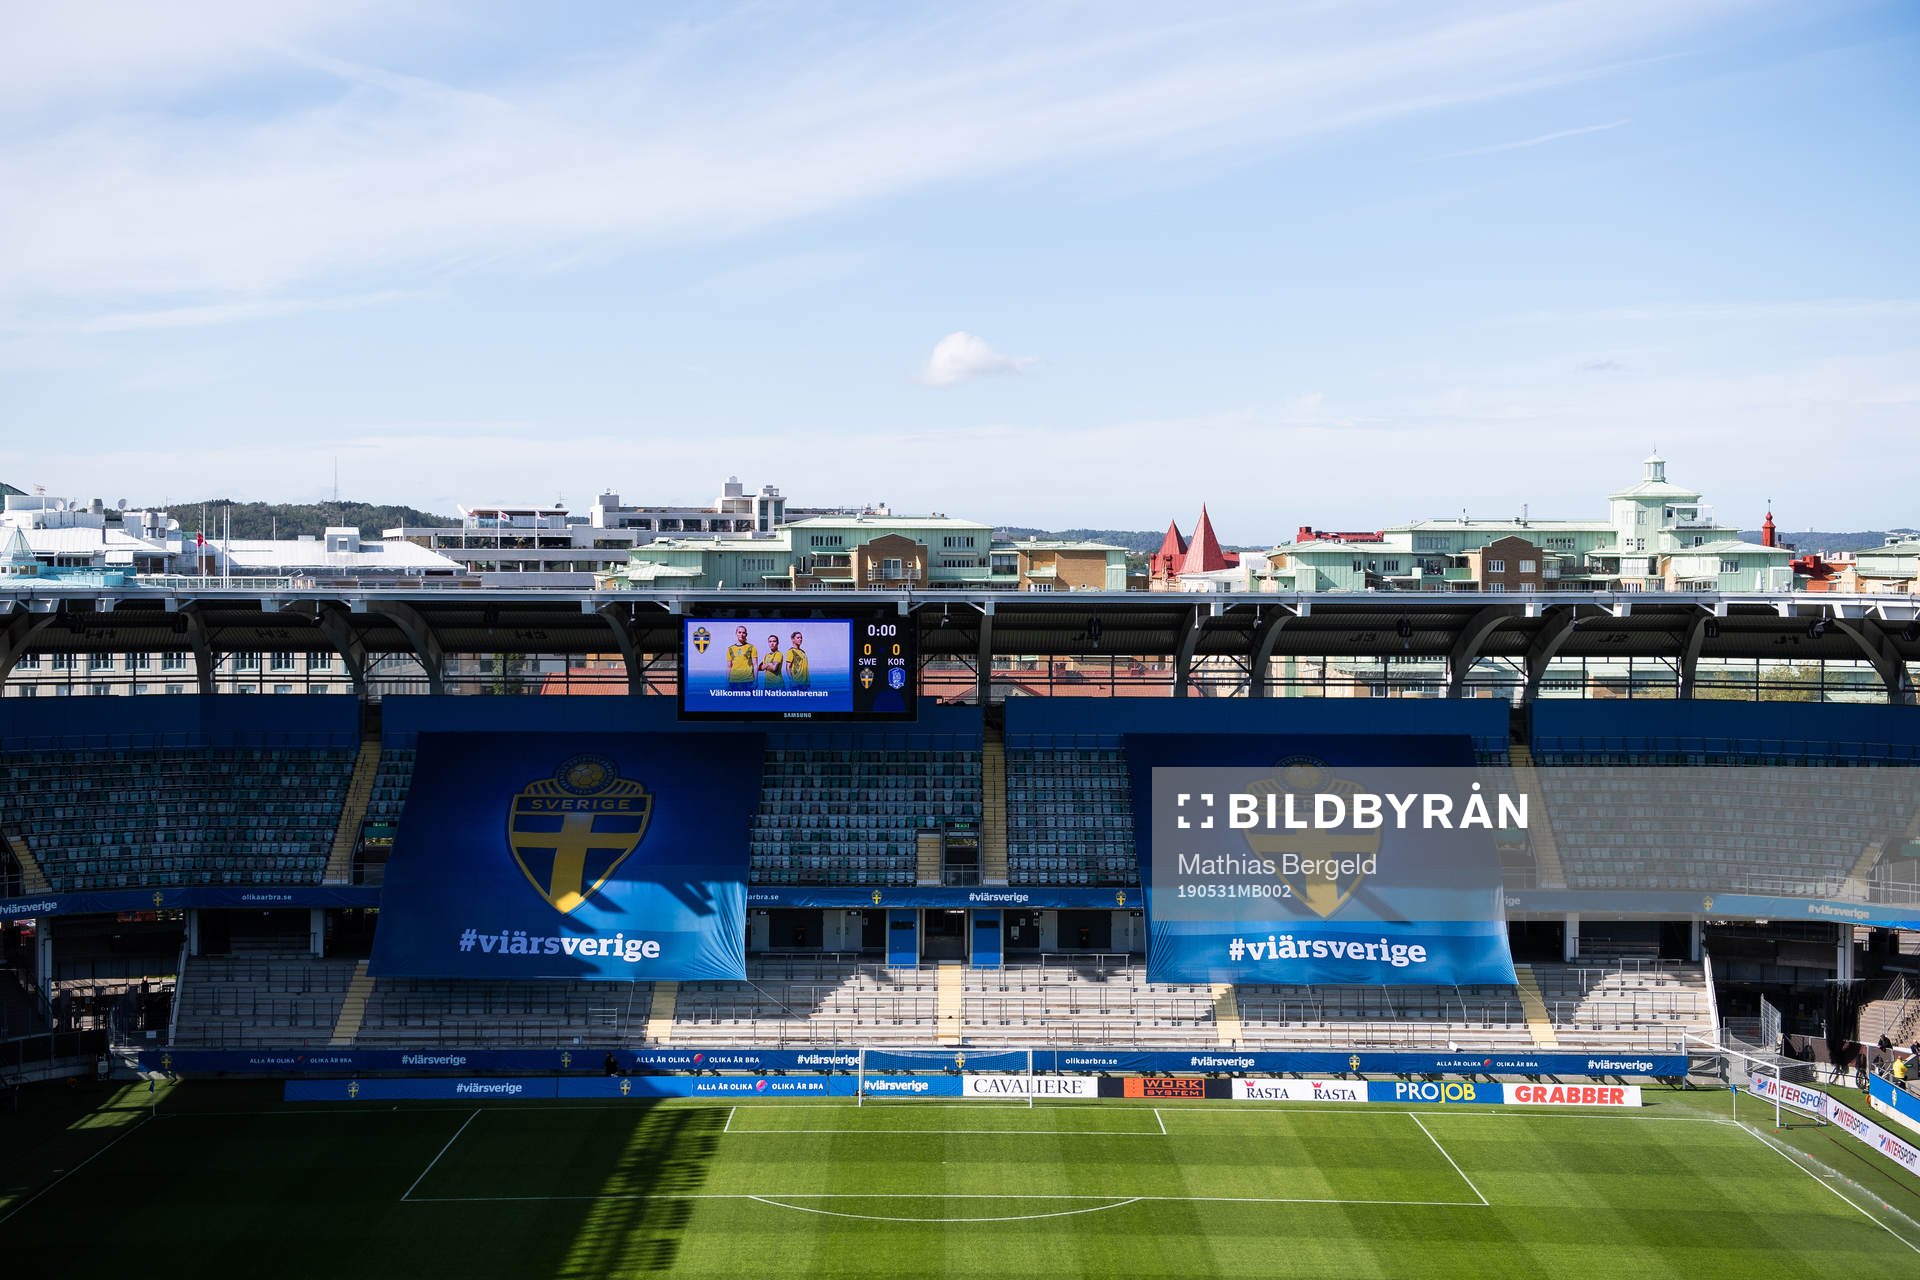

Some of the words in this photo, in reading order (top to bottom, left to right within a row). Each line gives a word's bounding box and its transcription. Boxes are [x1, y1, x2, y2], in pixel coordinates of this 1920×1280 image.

[867, 624, 897, 636] 0:00
[864, 643, 872, 656] 0
[892, 643, 900, 656] 0
[858, 657, 877, 666] SWE
[887, 657, 905, 666] KOR
[709, 689, 751, 697] Välkomna
[752, 689, 763, 697] till
[764, 689, 828, 697] Nationalarenan
[530, 799, 630, 810] SVERIGE
[241, 893, 292, 901] olikaarbra.se
[968, 891, 1029, 904] #viärsverige
[1807, 904, 1870, 920] #viärsverige
[459, 928, 660, 963] #viärsverige
[1228, 934, 1427, 968] #viärsverige
[402, 1055, 467, 1066] #viärsverige
[797, 1054, 859, 1066] #viärsverige
[1065, 1057, 1118, 1065] olikaarbra.se
[1190, 1056, 1255, 1067] #viärsverige
[1587, 1060, 1653, 1071] #viärsverige
[456, 1083, 523, 1094] #viärsverige
[864, 1080, 929, 1092] #viärsverige
[974, 1079, 1083, 1095] CAVALIERE
[1143, 1079, 1200, 1089] WORK
[1246, 1088, 1289, 1099] RASTA
[1313, 1089, 1356, 1100] RASTA
[1395, 1082, 1476, 1104] PROJOB
[1514, 1085, 1625, 1105] GRABBER
[1767, 1081, 1826, 1109] INTERSPORT
[1837, 1109, 1870, 1138] INTERSPORT
[1884, 1138, 1918, 1168] INTERSPORT
